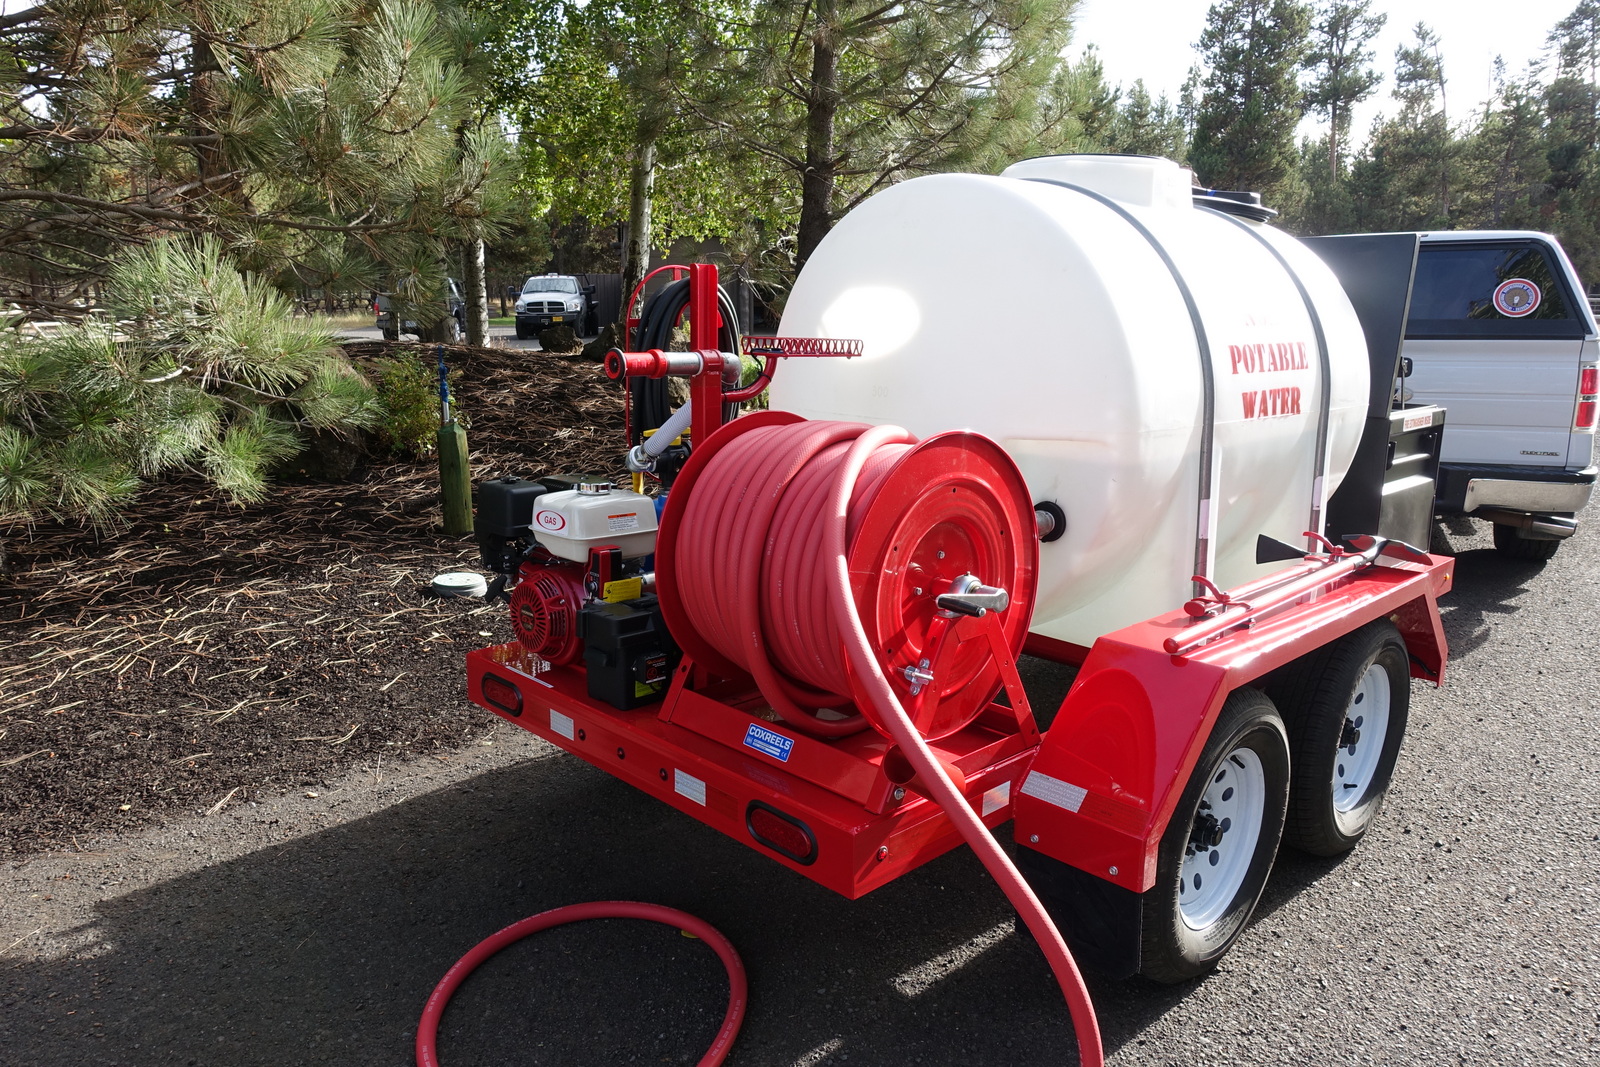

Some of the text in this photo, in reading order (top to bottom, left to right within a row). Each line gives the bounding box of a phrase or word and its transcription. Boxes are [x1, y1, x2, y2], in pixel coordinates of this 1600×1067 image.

[1228, 342, 1308, 374] POTABLE
[1242, 386, 1302, 420] WATER
[544, 515, 557, 526] GAS
[749, 726, 791, 751] COXREELS
